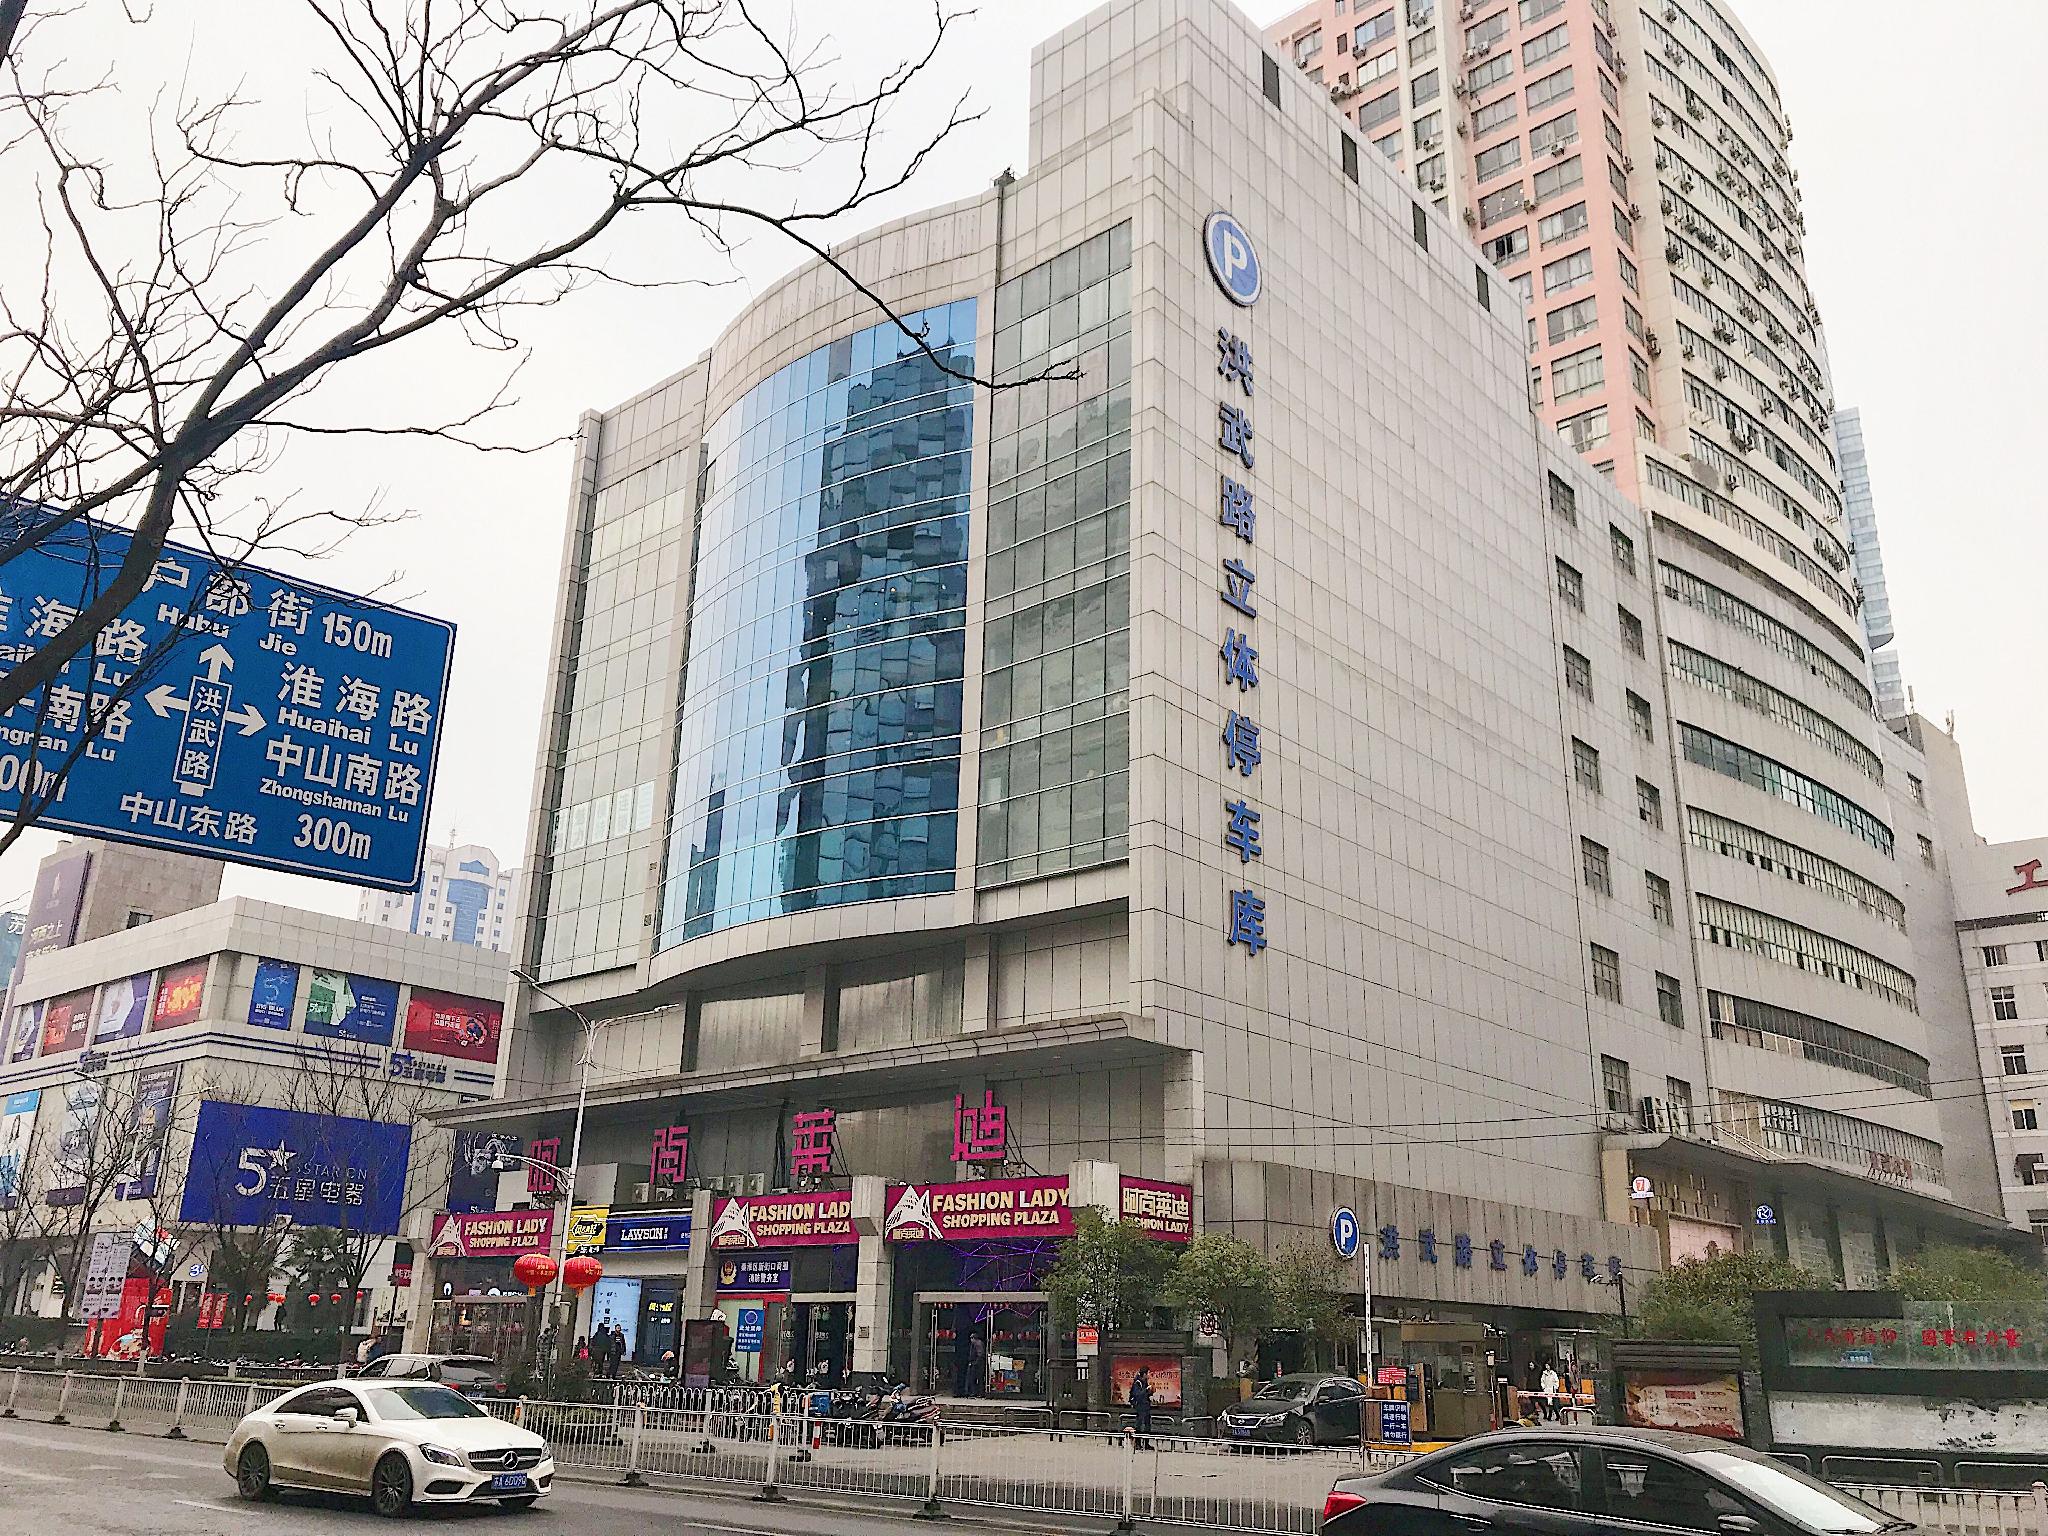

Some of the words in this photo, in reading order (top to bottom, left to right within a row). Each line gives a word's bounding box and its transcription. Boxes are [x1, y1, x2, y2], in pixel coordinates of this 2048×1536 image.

[141, 557, 314, 635] 户部街
[322, 612, 393, 659] 150m
[157, 604, 230, 639] Hubu
[259, 633, 298, 656] Jie
[1217, 326, 1268, 957] 洪武路立体停车库
[277, 661, 433, 736] 淮海路
[181, 686, 222, 780] 洪武路
[277, 707, 372, 745] Huaihai
[388, 733, 419, 756] Lu
[85, 741, 115, 762] Lu
[266, 734, 423, 807] 中山南路
[120, 791, 258, 845] 中山东路
[259, 777, 382, 818] Zhongshannan
[388, 805, 409, 823] Lu
[293, 813, 372, 860] 300m
[267, 1175, 365, 1205] 五星电器
[932, 1190, 1015, 1212] FASHION
[1019, 1188, 1069, 1208] LADY
[464, 1219, 514, 1236] FASHION
[516, 1217, 548, 1234] LADY
[749, 1203, 816, 1222] FASHION
[819, 1201, 851, 1219] LAD
[756, 1222, 812, 1237] SHOPPING
[814, 1221, 850, 1235] PLAZA
[942, 1212, 1011, 1229] SHOPPING
[1014, 1210, 1059, 1226] PLAZA
[1165, 1221, 1189, 1233] LADY
[469, 1236, 511, 1248] SHOPPING
[511, 1235, 539, 1247] PLAZA
[620, 1228, 664, 1241] LAWSON
